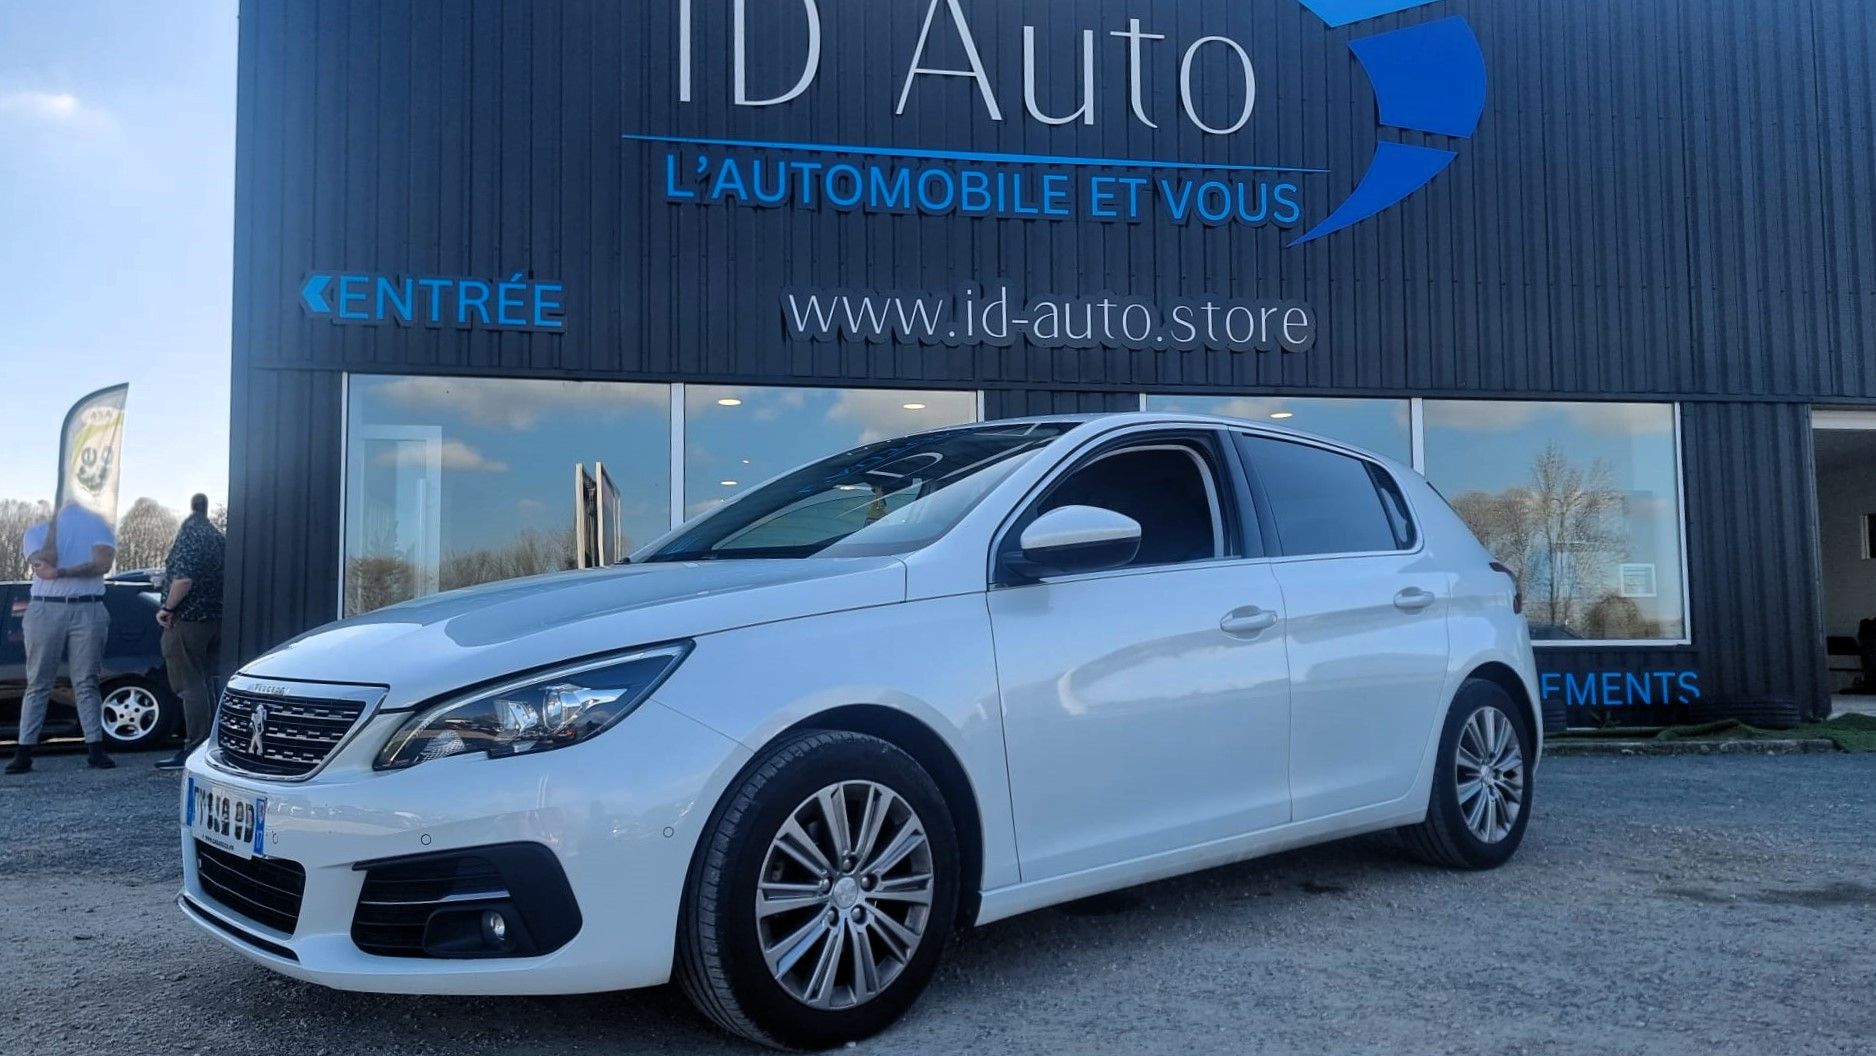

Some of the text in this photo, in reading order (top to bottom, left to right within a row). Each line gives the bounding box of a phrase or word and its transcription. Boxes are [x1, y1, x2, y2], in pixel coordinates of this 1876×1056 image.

[679, 0, 1256, 135] ID Auto
[666, 153, 1300, 223] L'AUTOMOBILE ET VOUS
[339, 272, 563, 328] ENTRÉE
[788, 286, 1309, 344] www.id-auto.store
